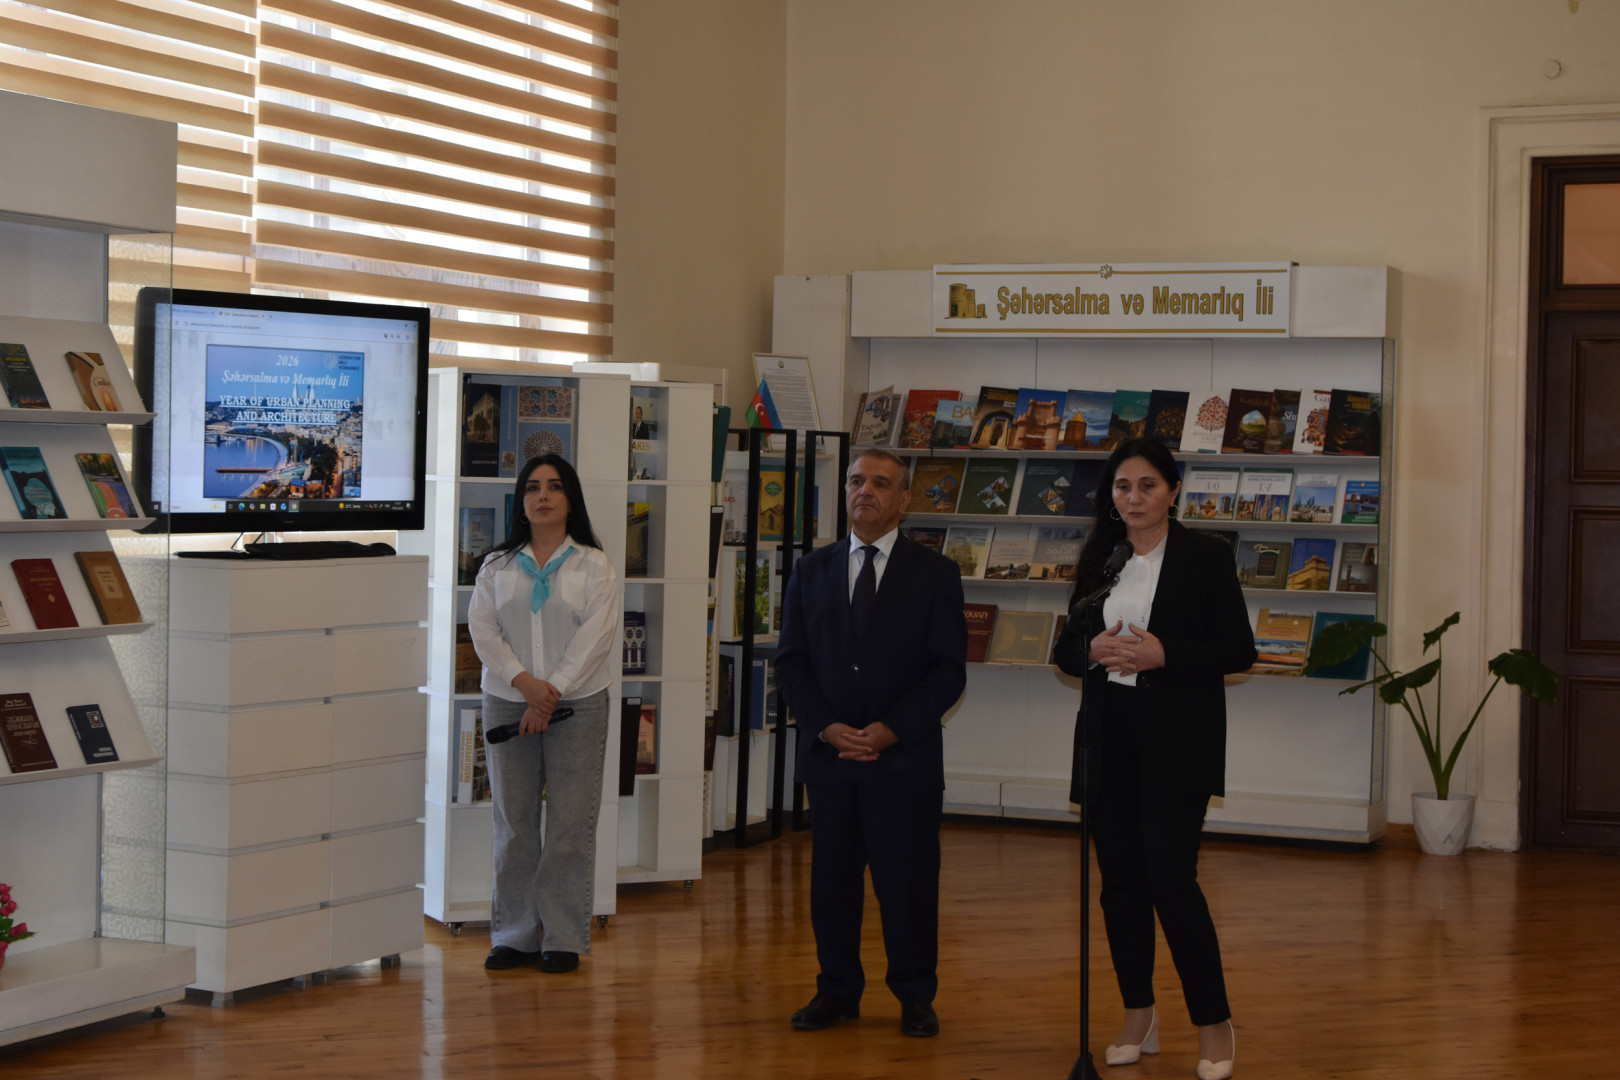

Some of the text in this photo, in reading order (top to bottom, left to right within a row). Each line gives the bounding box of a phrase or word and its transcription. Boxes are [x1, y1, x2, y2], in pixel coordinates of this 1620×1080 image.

[997, 279, 1274, 321] Şəhərsalma və Memarlıq İli
[276, 354, 299, 366] 2026
[222, 369, 350, 388] Şəhərsalma və Memarlıq İli
[219, 394, 351, 409] YEAR OF URBAN PLANNING
[236, 410, 337, 423] AND ARCHITECTURE
